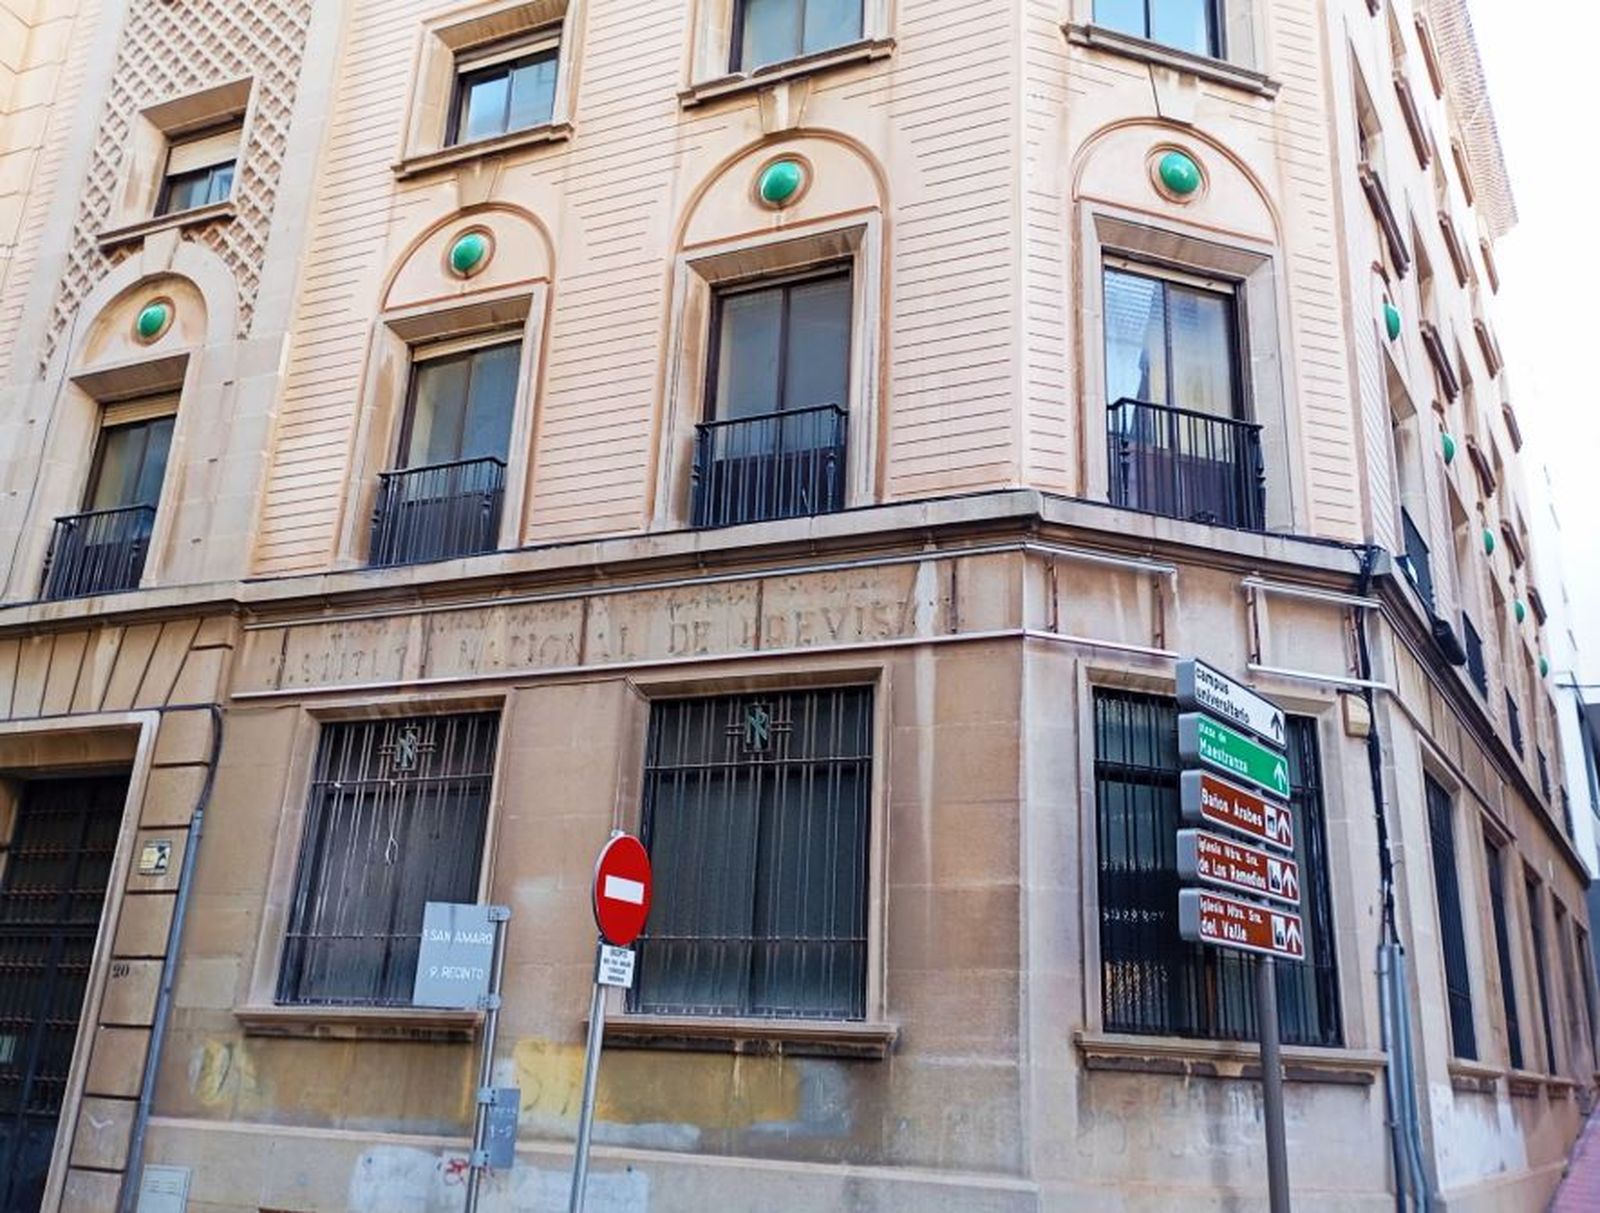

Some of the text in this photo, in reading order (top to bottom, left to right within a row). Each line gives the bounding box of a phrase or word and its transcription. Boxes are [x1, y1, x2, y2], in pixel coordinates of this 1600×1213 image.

[668, 621, 710, 656] DE
[1196, 666, 1229, 696] campus
[1197, 687, 1250, 724] universitario
[1200, 736, 1249, 774] Maestranza
[1201, 787, 1229, 813] Baños
[1198, 837, 1222, 856] Iglesia
[1198, 859, 1267, 889] de Los Remedios
[1200, 896, 1224, 914] Iglesia
[430, 928, 451, 942] SAN
[454, 929, 493, 945] AMARO
[1201, 920, 1247, 942] del Valle
[112, 963, 130, 978] 20
